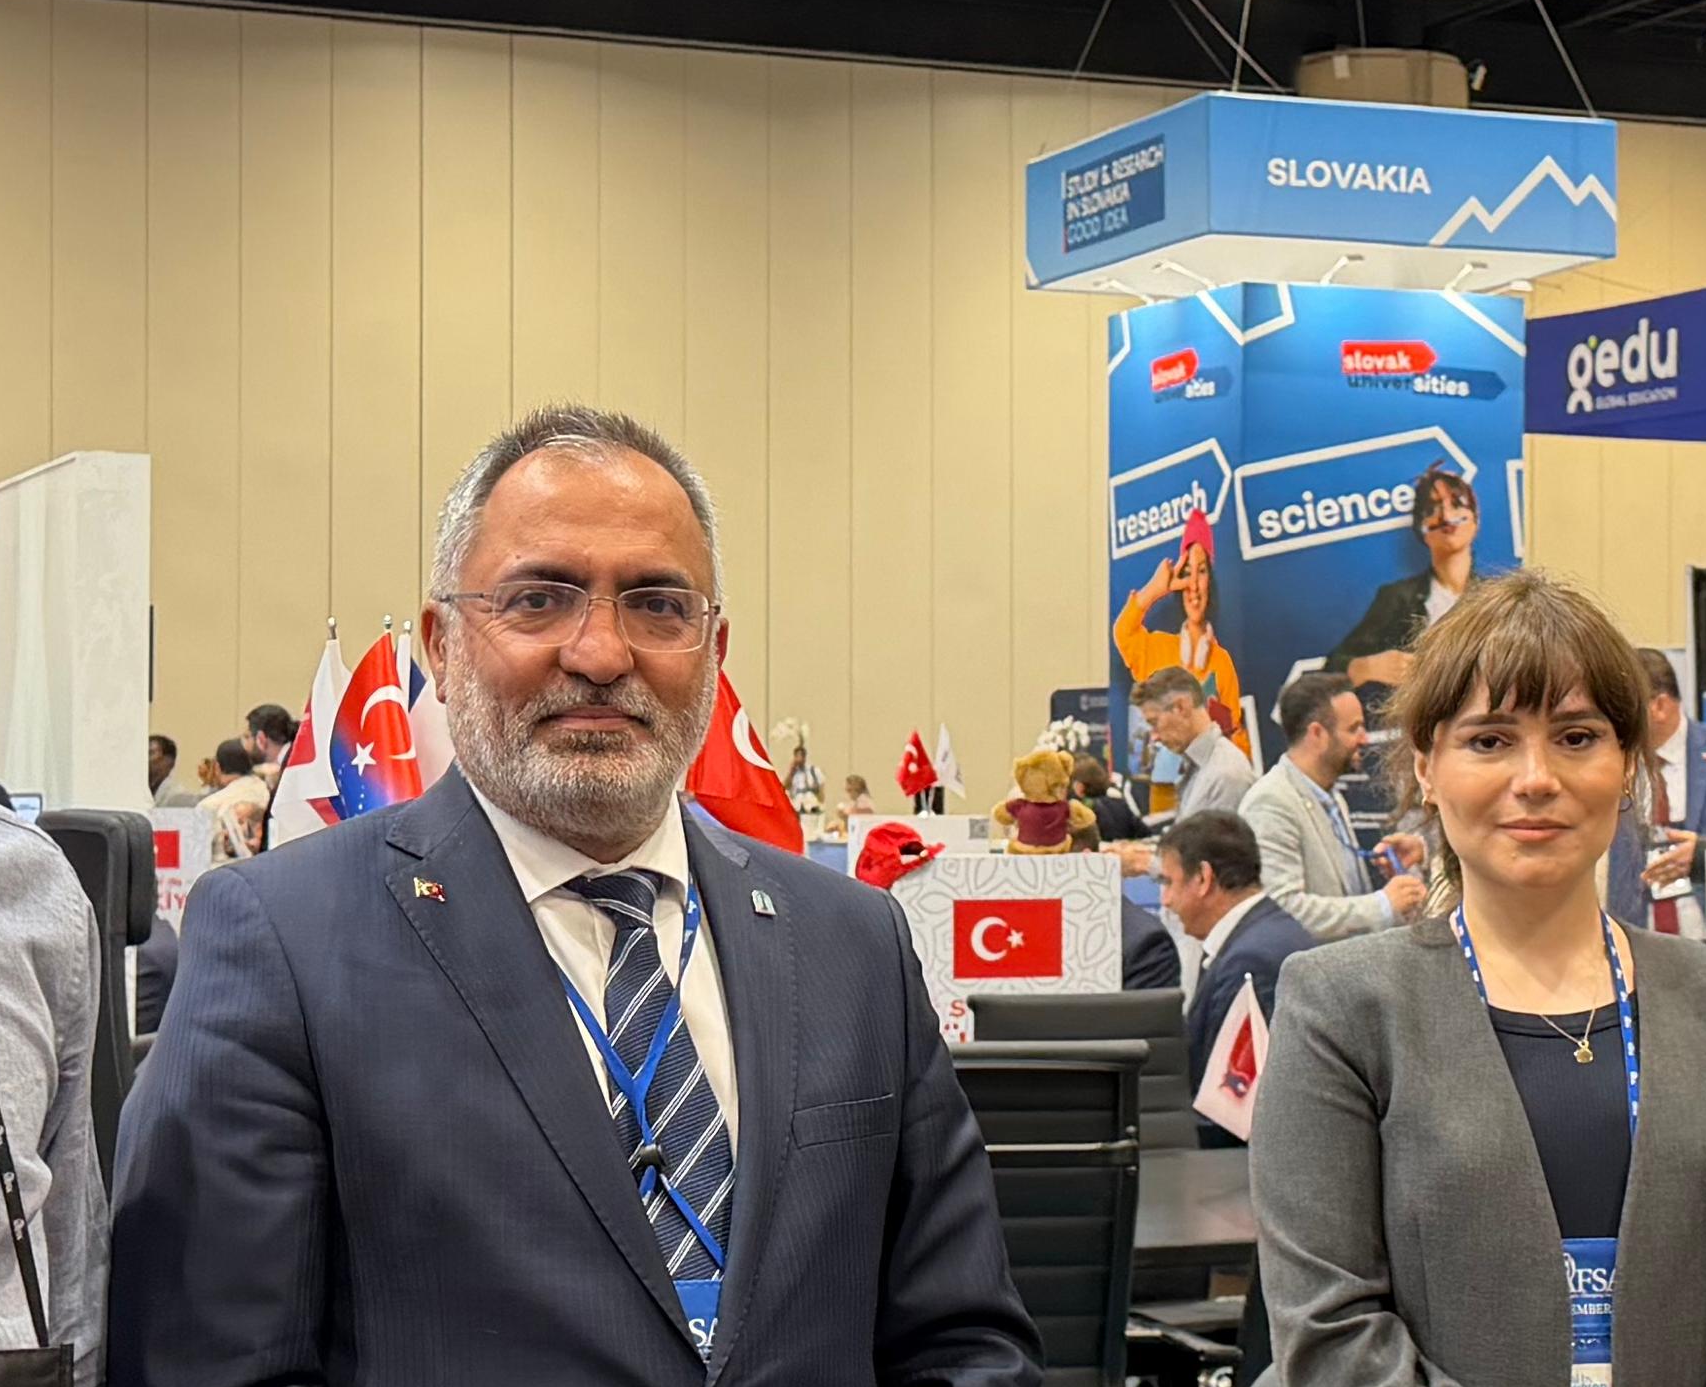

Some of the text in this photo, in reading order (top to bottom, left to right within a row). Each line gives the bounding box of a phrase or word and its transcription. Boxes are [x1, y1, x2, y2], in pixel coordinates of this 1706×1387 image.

[1267, 157, 1431, 196] SLOVAKIA
[1342, 349, 1412, 372] slovak
[1116, 481, 1208, 543] research
[1258, 483, 1416, 540] science
